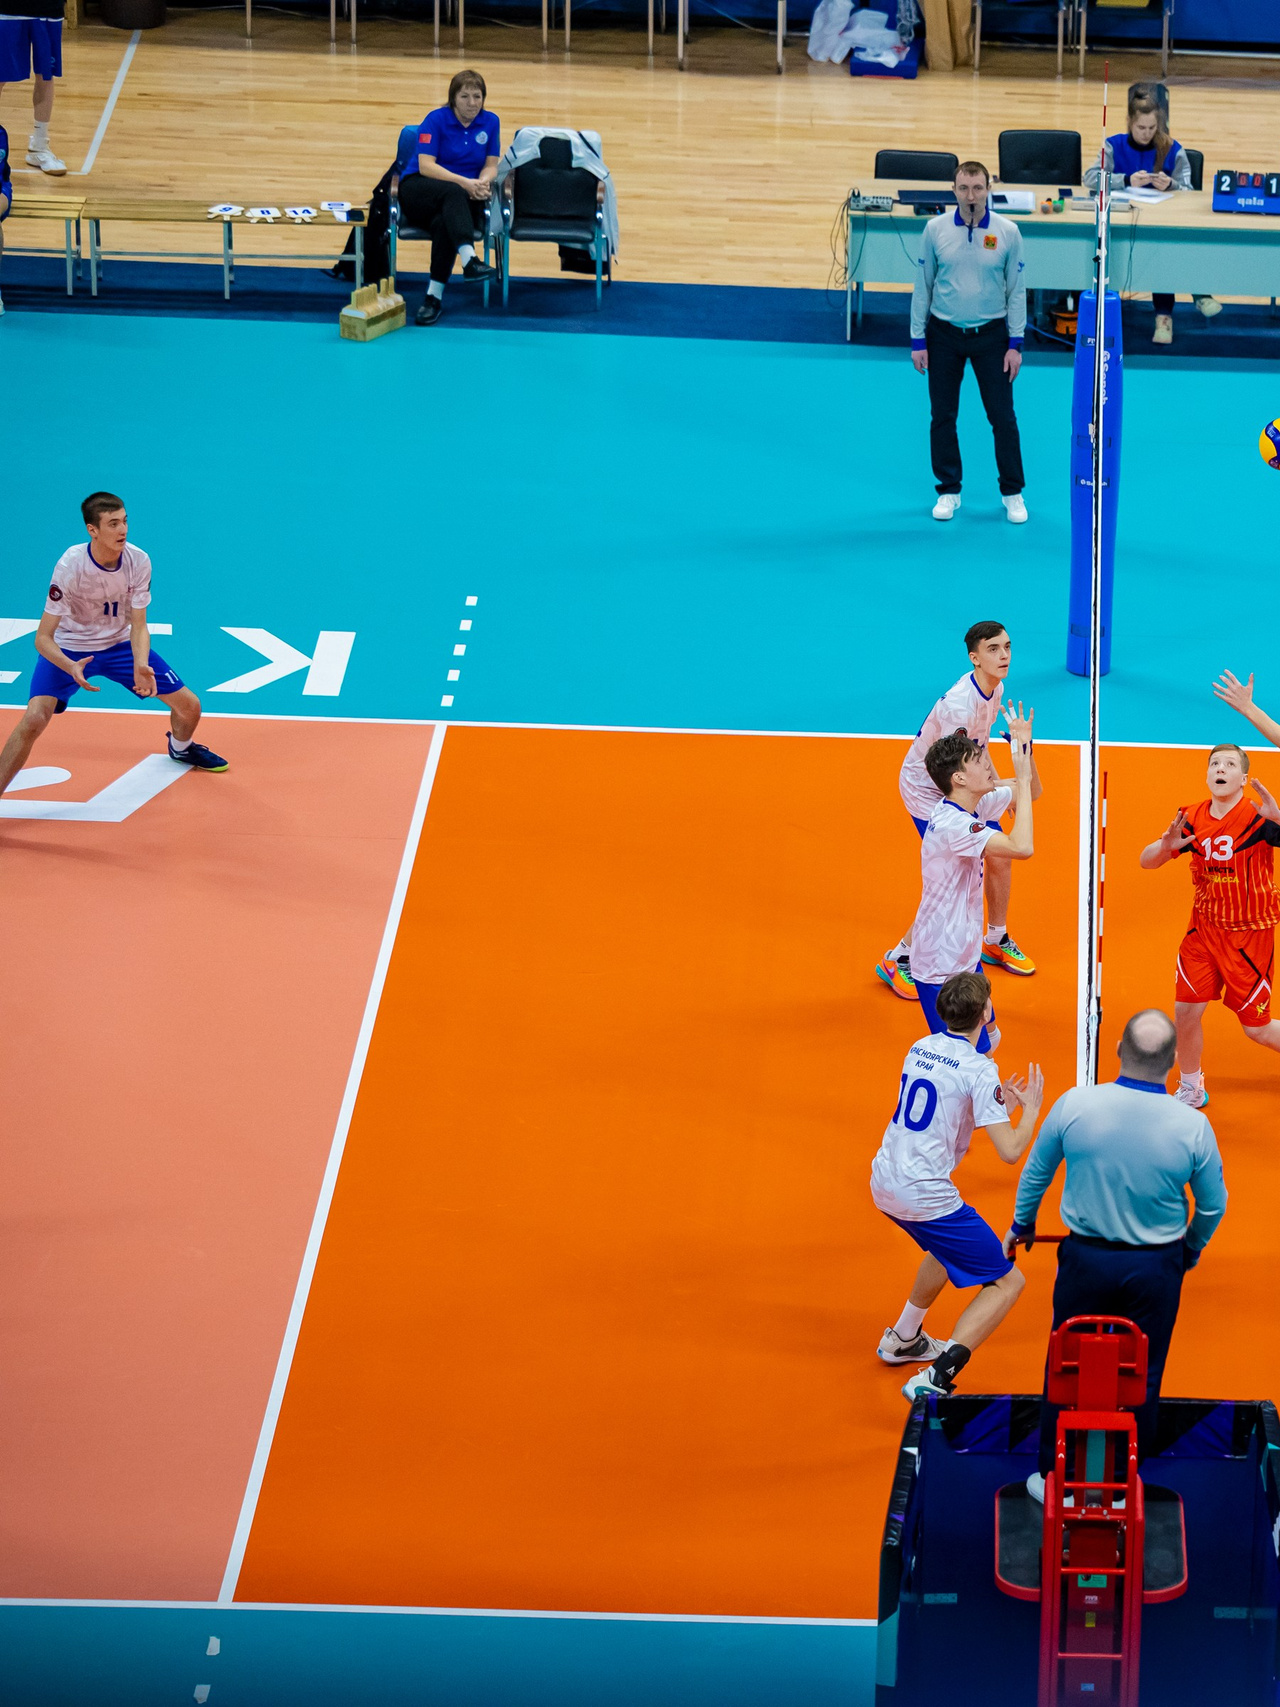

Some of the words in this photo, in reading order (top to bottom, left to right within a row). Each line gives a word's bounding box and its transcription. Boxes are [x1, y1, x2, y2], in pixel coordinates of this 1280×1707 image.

[1220, 175, 1231, 192] 2
[1269, 177, 1277, 194] 1
[290, 208, 313, 216] 14
[103, 601, 119, 617] 11
[165, 669, 179, 685] 11
[1201, 834, 1234, 861] 13
[914, 1059, 935, 1072] КРАЙ
[892, 1073, 938, 1132] 10
